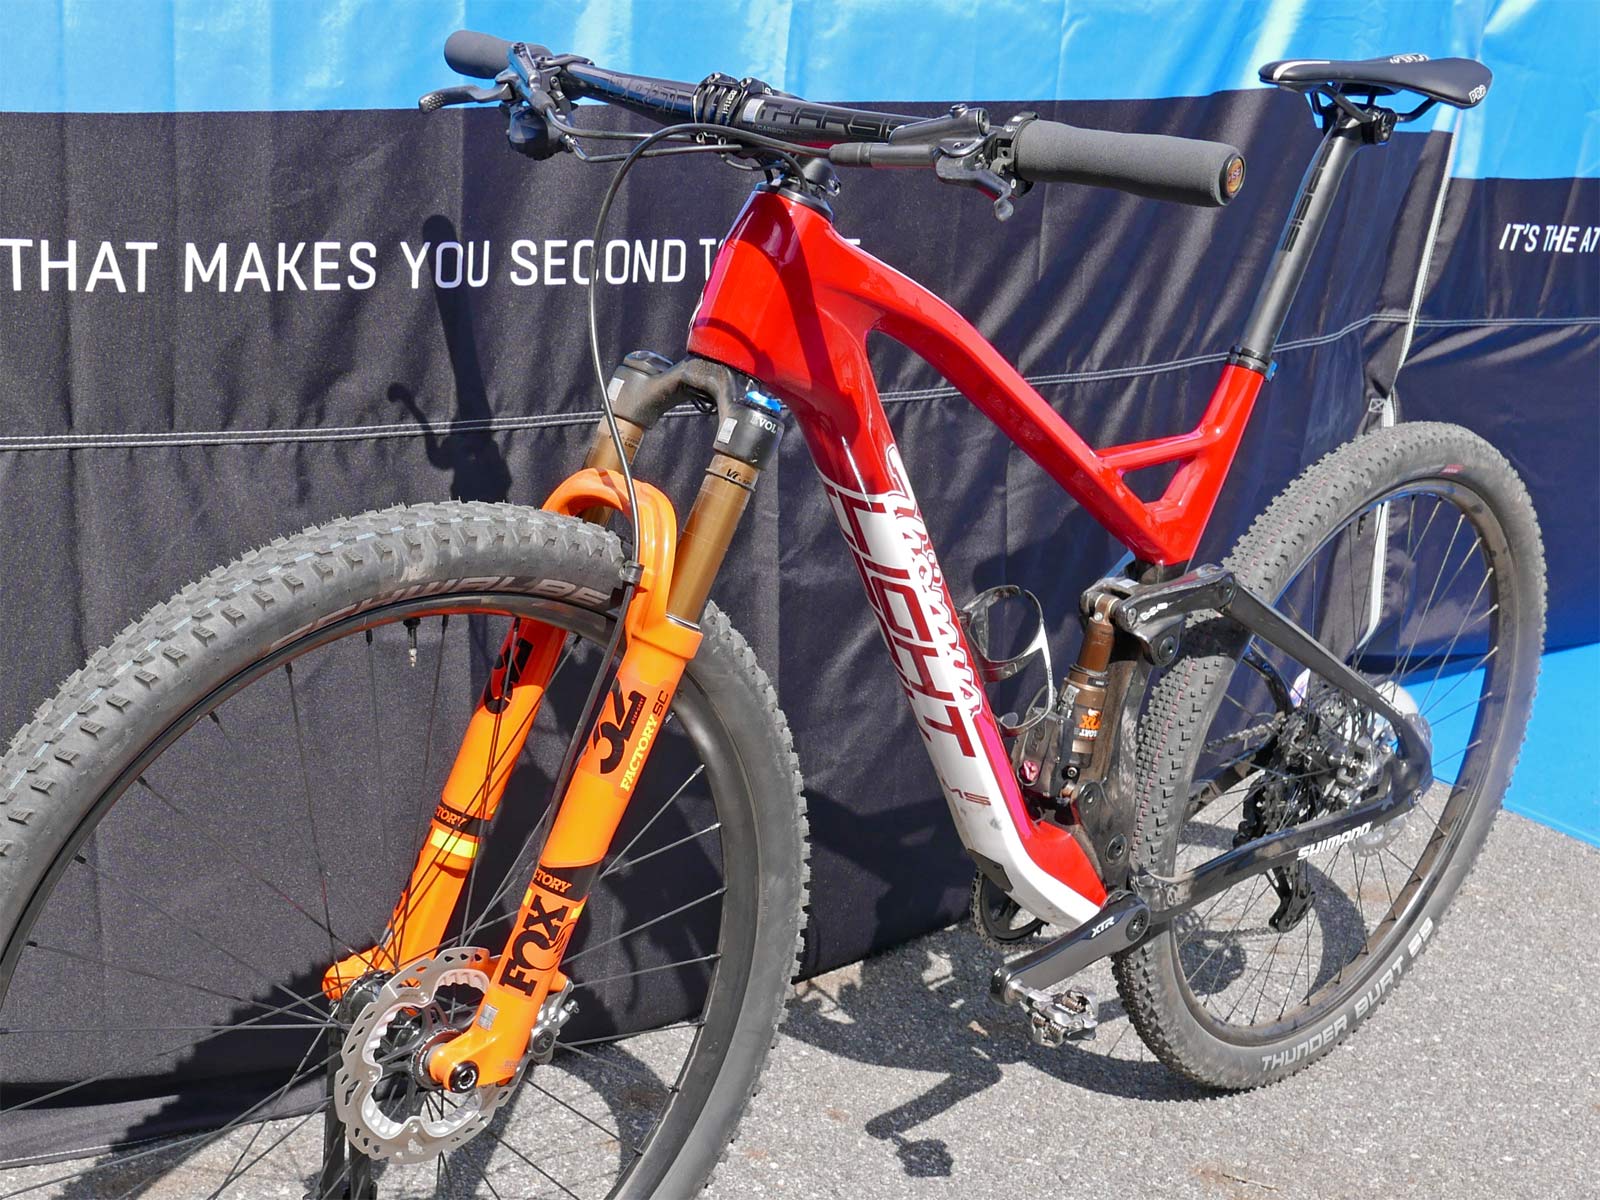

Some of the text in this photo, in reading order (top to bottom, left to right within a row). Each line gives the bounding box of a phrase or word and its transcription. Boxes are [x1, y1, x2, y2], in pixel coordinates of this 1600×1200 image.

[759, 101, 896, 138] THARSI
[1498, 222, 1541, 252] IT'S
[1542, 224, 1581, 253] THE
[0, 237, 725, 293] THAT MAKES YOU SECOND T
[619, 690, 669, 792] FACTORY SC
[434, 806, 468, 828] TORY
[1296, 821, 1372, 861] SHIMANO
[498, 895, 575, 997] FOX
[1090, 916, 1117, 938] XTR
[1261, 1013, 1348, 1072] THUNDER
[1353, 955, 1405, 1019] BURT
